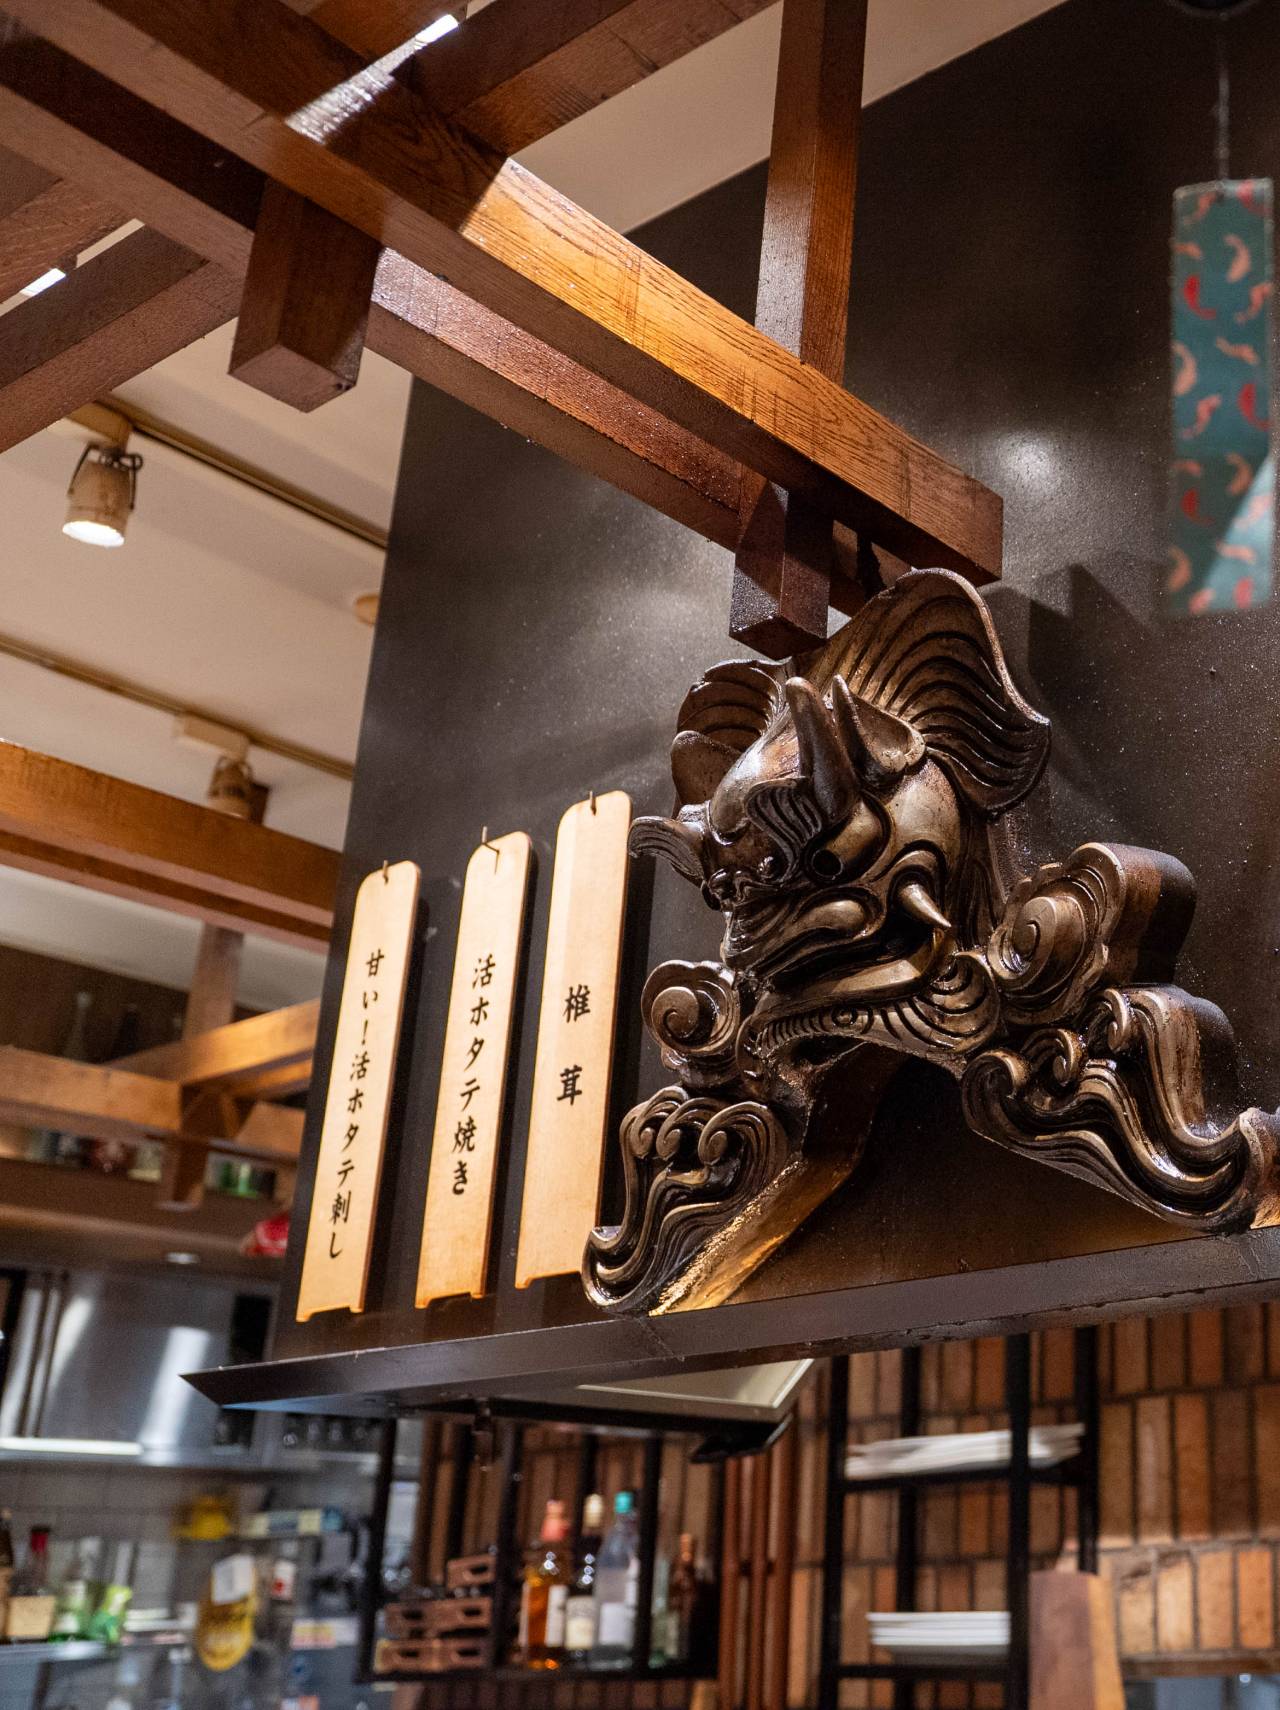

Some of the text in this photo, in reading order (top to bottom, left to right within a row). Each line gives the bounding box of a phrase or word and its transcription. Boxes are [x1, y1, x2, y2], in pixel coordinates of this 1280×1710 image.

[452, 953, 496, 1195] 活ホタテ焼き
[556, 984, 591, 1106] 椎茸
